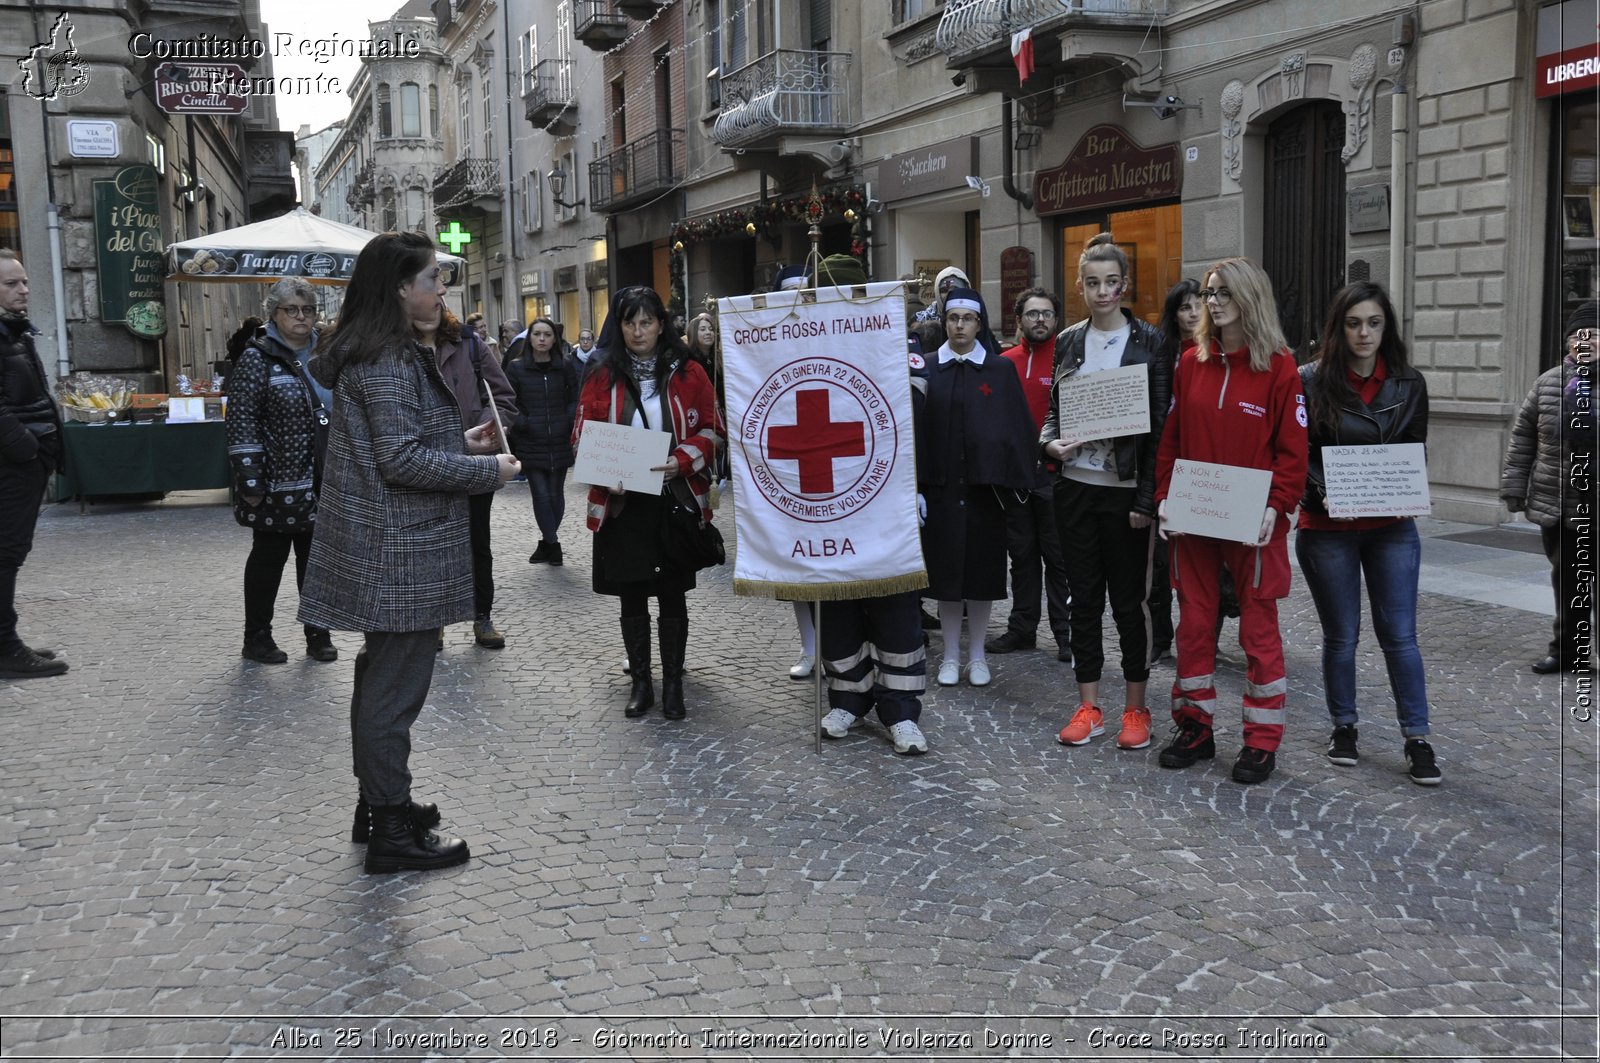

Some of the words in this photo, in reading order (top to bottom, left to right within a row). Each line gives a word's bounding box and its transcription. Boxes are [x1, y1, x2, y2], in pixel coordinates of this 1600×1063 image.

[1391, 48, 1401, 64] 32
[1086, 135, 1119, 158] Bar
[1039, 168, 1107, 209] Caffetteria
[1110, 158, 1172, 191] Maestra
[111, 206, 119, 227] i
[106, 230, 136, 252] del
[138, 231, 163, 253] Gu
[242, 253, 298, 272] Tartufi
[734, 327, 777, 346] CROCE
[782, 321, 827, 340] ROSSA
[832, 314, 892, 335] ITALIANA
[745, 378, 783, 440] CONVENZIONE
[782, 371, 792, 385] DI
[793, 363, 831, 379] GINEVRA
[833, 367, 847, 381] 22
[848, 378, 880, 410] AGOSTO
[874, 410, 890, 431] 1864
[1331, 448, 1357, 456] NADIA
[1190, 467, 1210, 476] NON
[754, 464, 779, 498] CORPO
[778, 495, 836, 517] INFERMIERE
[839, 458, 889, 512] VOLONTARIE
[1175, 491, 1193, 500] CHE
[1190, 480, 1231, 492] NORMALE
[1190, 506, 1231, 519] NORMALE
[791, 537, 856, 558] ALBA
